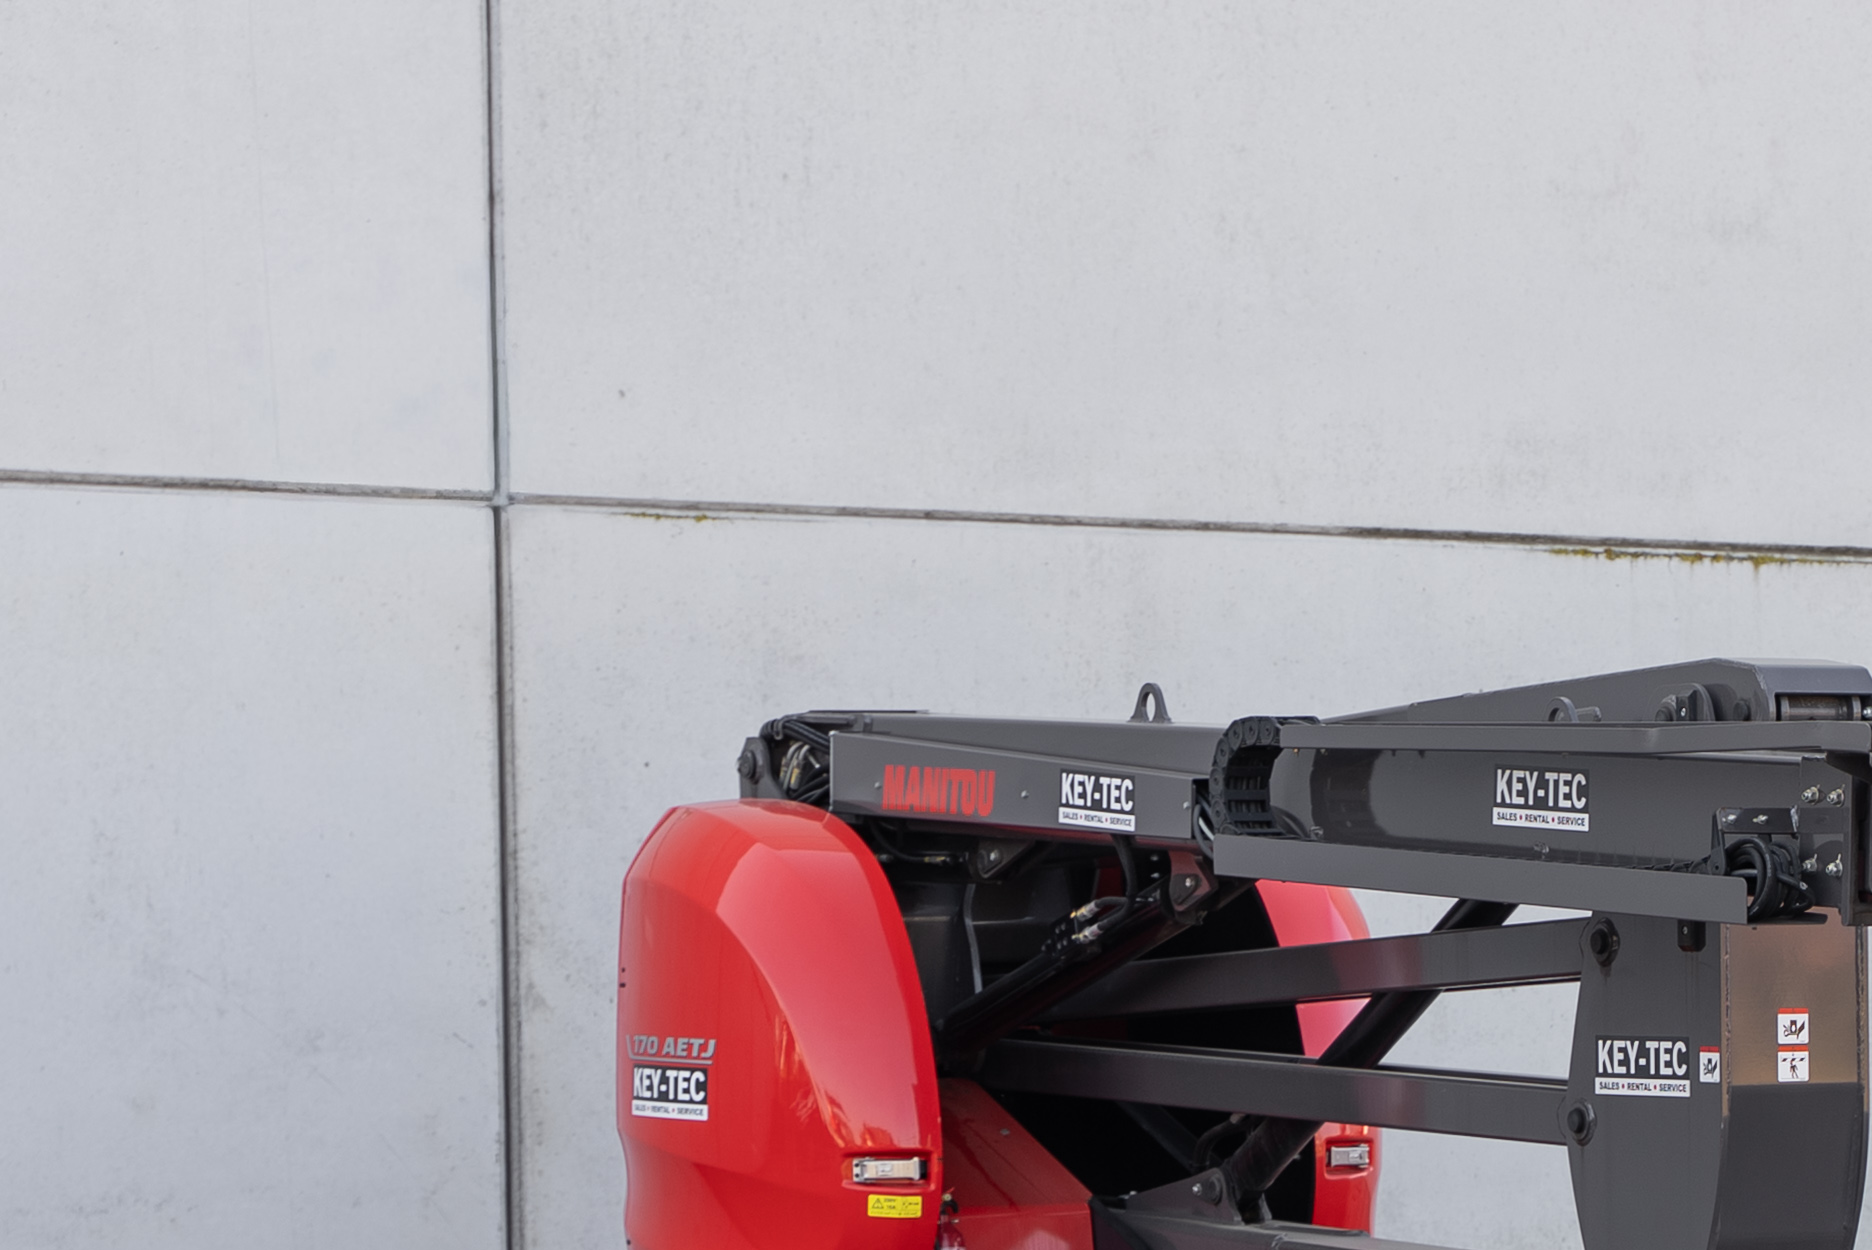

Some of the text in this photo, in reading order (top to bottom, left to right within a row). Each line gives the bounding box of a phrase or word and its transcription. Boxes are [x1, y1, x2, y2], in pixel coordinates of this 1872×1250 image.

[882, 764, 996, 817] MANITOU
[1061, 772, 1133, 812] KEY-TEC
[1496, 769, 1587, 809] KEY-TEC
[1497, 811, 1585, 827] SALES RENTAL SERVICE
[633, 1035, 717, 1058] 170 AETJ
[1598, 1039, 1688, 1076] KEY-TEC
[633, 1066, 706, 1102] KEY-TEC
[1599, 1081, 1687, 1093] SALES RENTAL SERVICE
